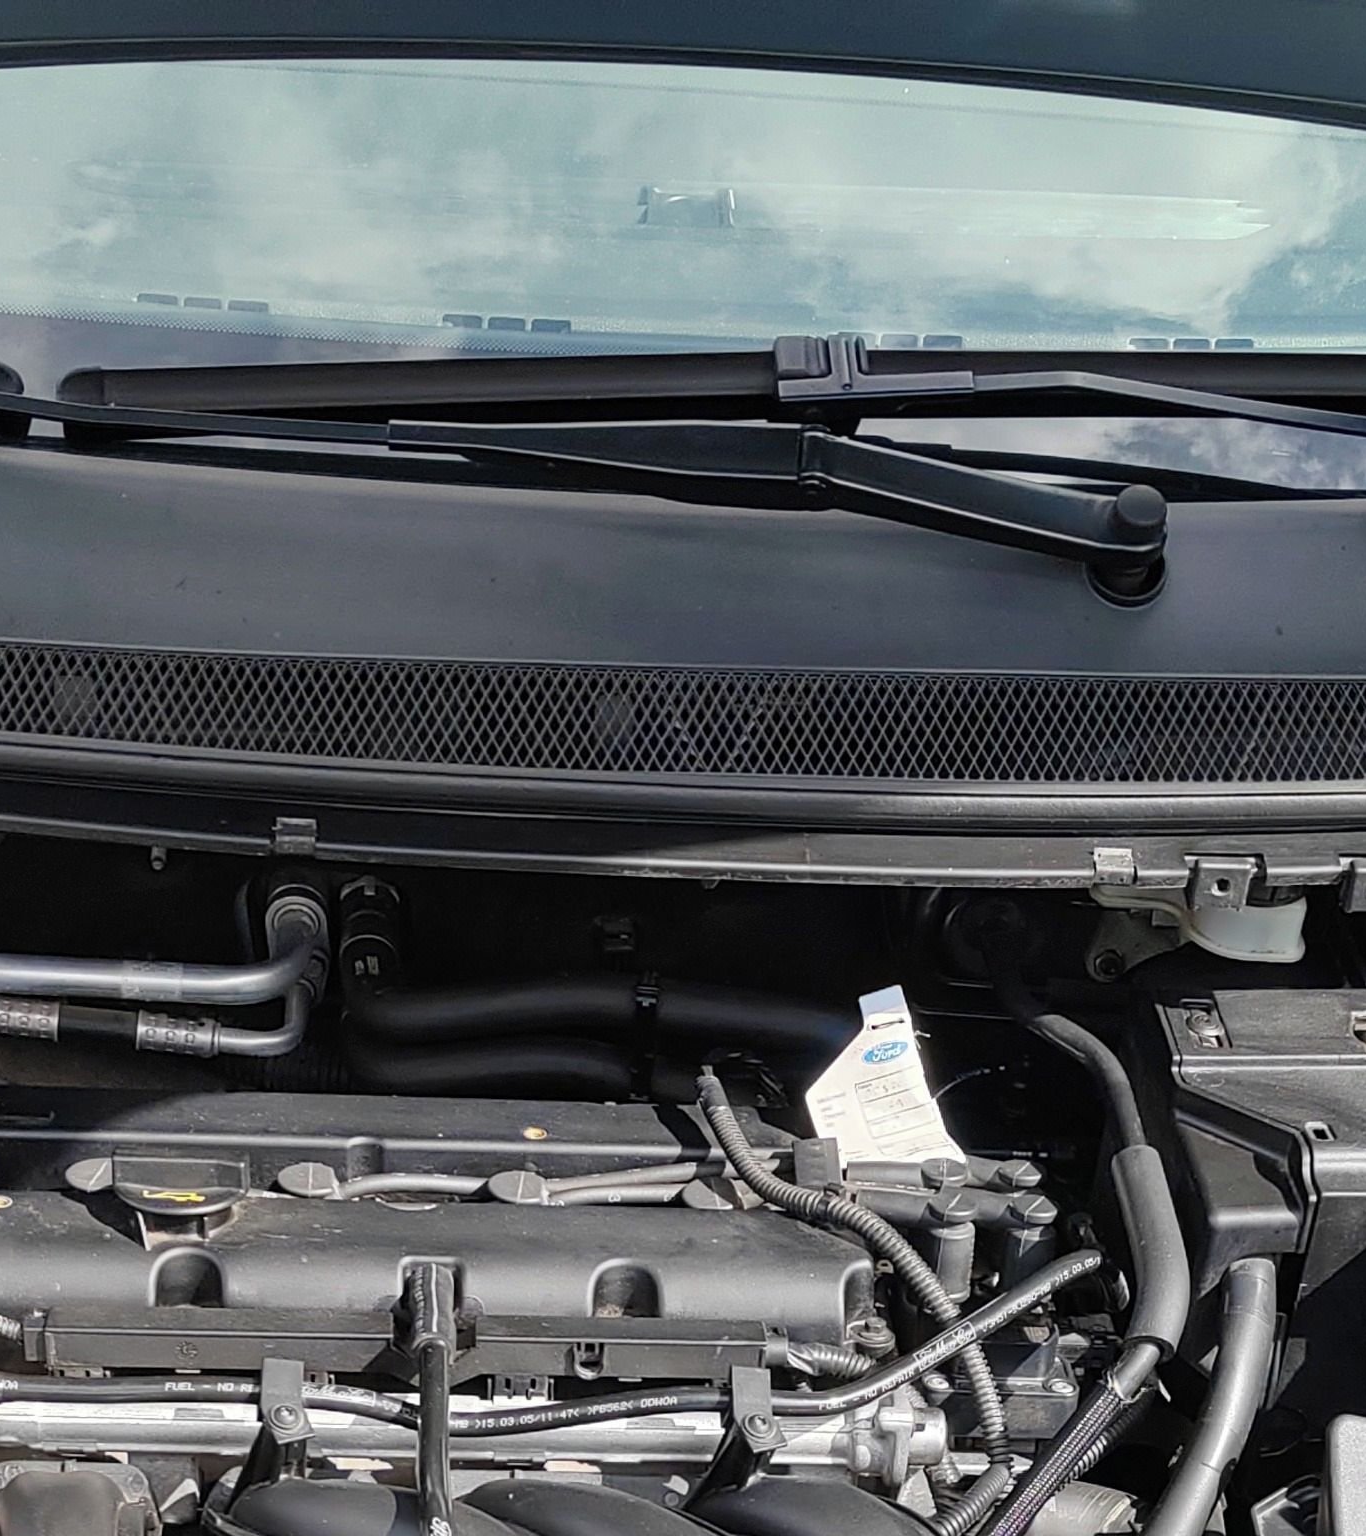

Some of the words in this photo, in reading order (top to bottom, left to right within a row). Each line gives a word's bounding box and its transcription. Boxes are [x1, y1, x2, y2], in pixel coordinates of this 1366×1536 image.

[873, 1043, 903, 1062] Ford
[164, 1381, 195, 1392] FUEL
[216, 1382, 234, 1393] NO
[818, 1401, 847, 1411] FUEL
[865, 1388, 877, 1400] NO
